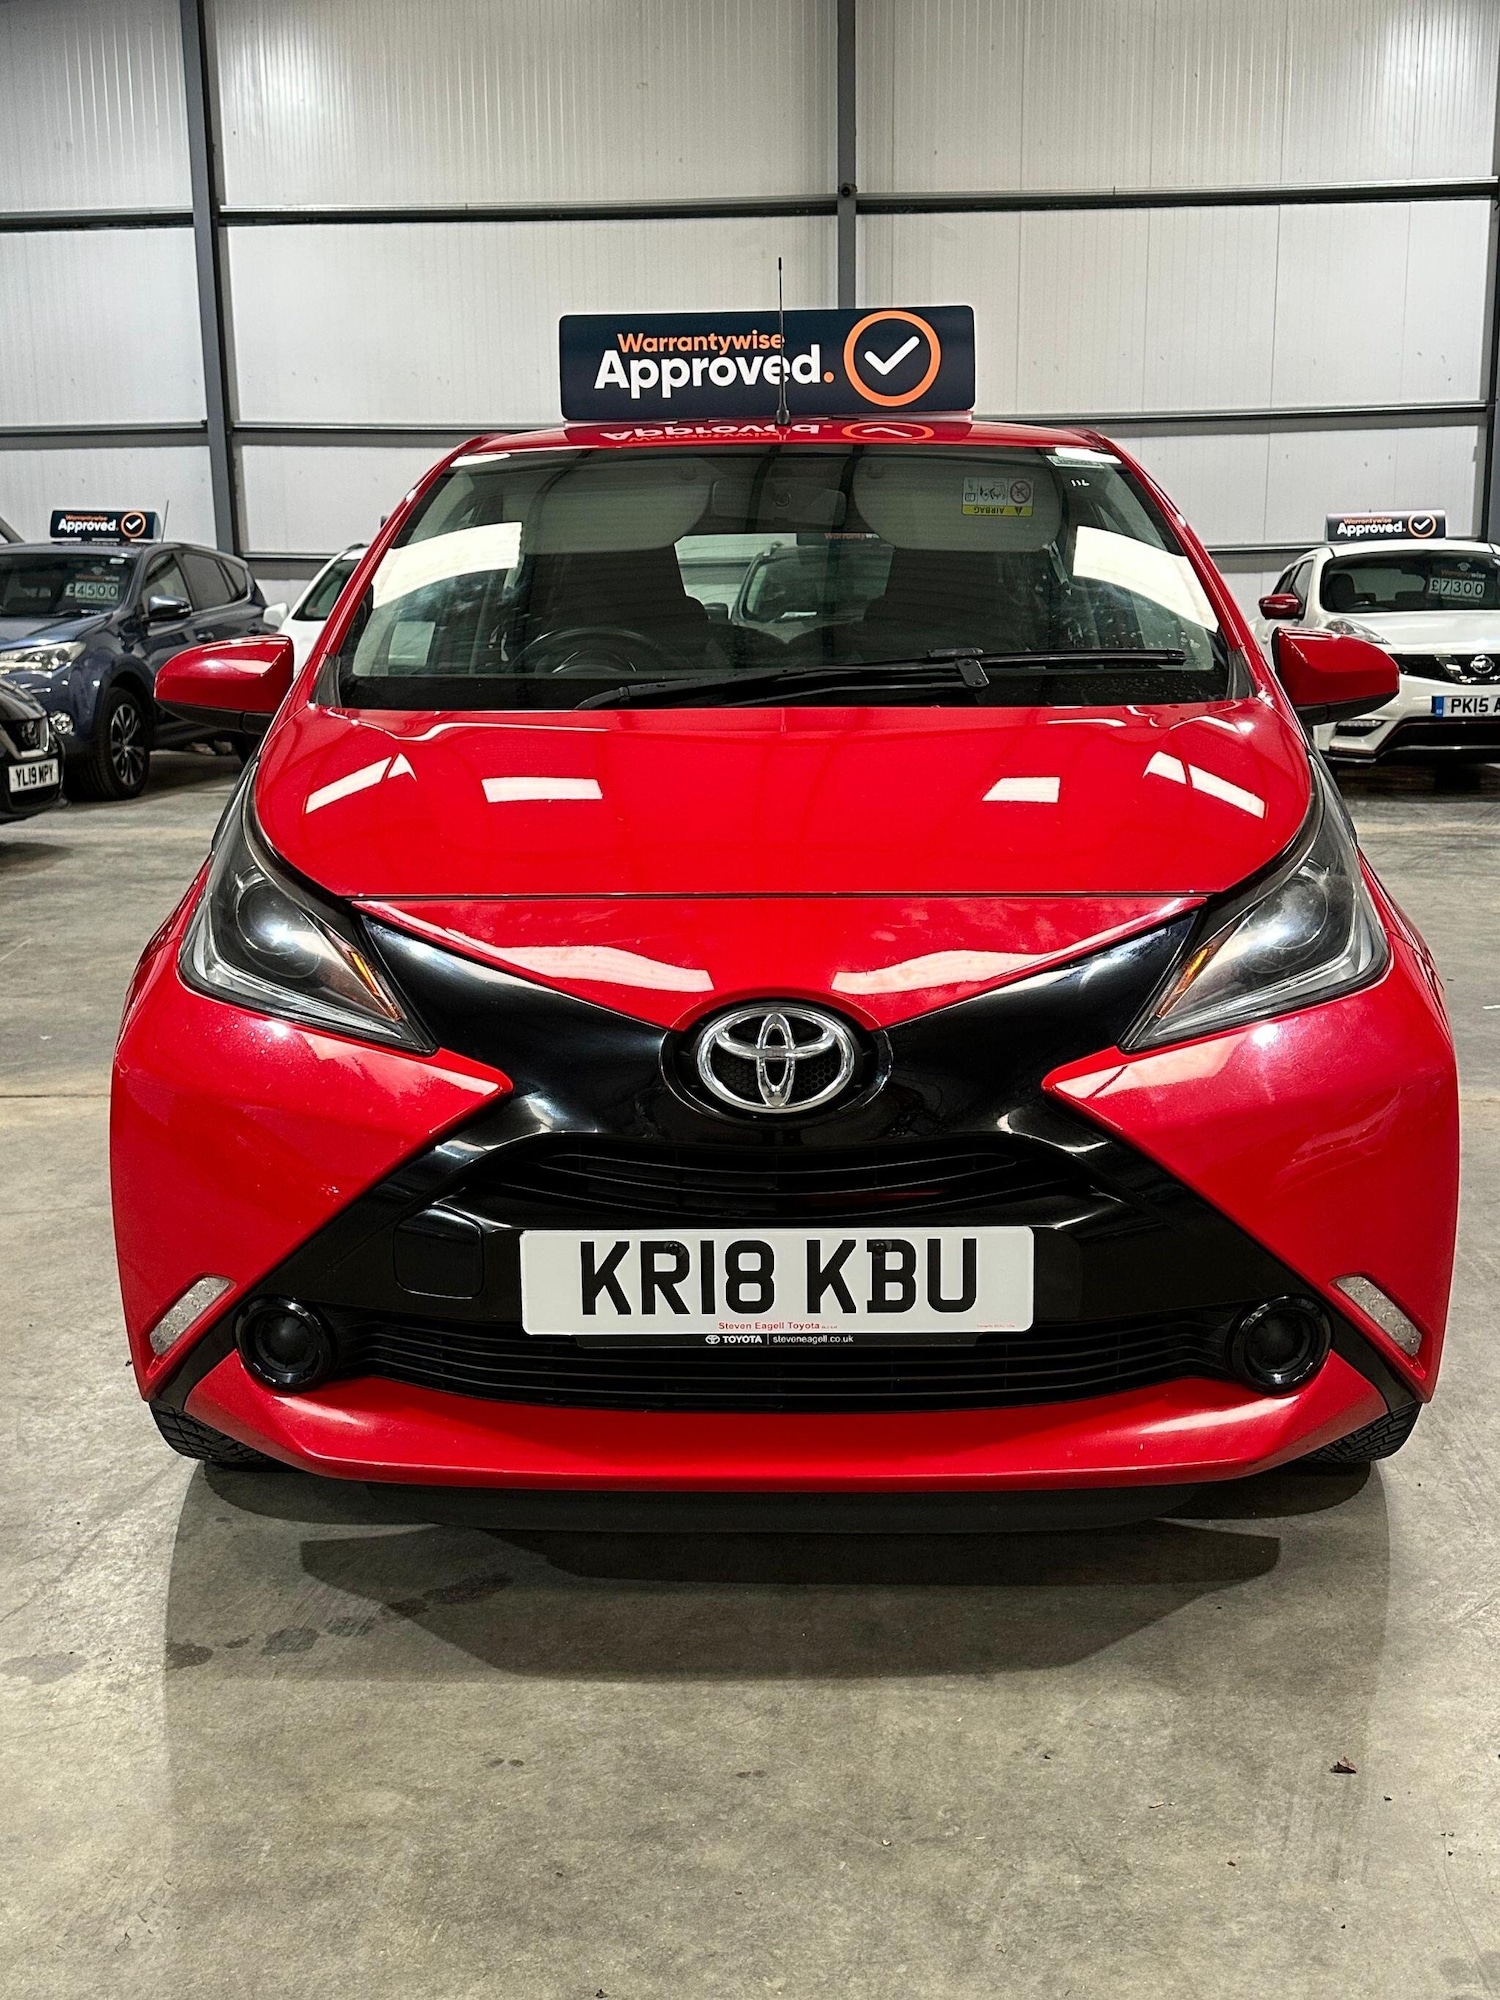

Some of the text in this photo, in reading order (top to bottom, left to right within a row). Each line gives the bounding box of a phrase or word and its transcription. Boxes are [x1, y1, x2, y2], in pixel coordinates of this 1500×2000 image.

[617, 330, 786, 355] Warrantywise
[594, 344, 835, 399] Approved.
[974, 506, 1005, 514] AIRBAG
[1337, 521, 1406, 537] Approved.
[65, 583, 117, 597] £4500
[1431, 579, 1483, 595] £7300
[1451, 697, 1489, 713] PK15
[15, 766, 37, 787] YL19
[580, 1238, 977, 1315] KR18 KBU
[718, 1322, 751, 1330] Steven
[754, 1321, 785, 1331] Eagell
[787, 1321, 820, 1330] Toyota
[723, 1334, 854, 1345] TOYOTA steveneagell.co.uk
